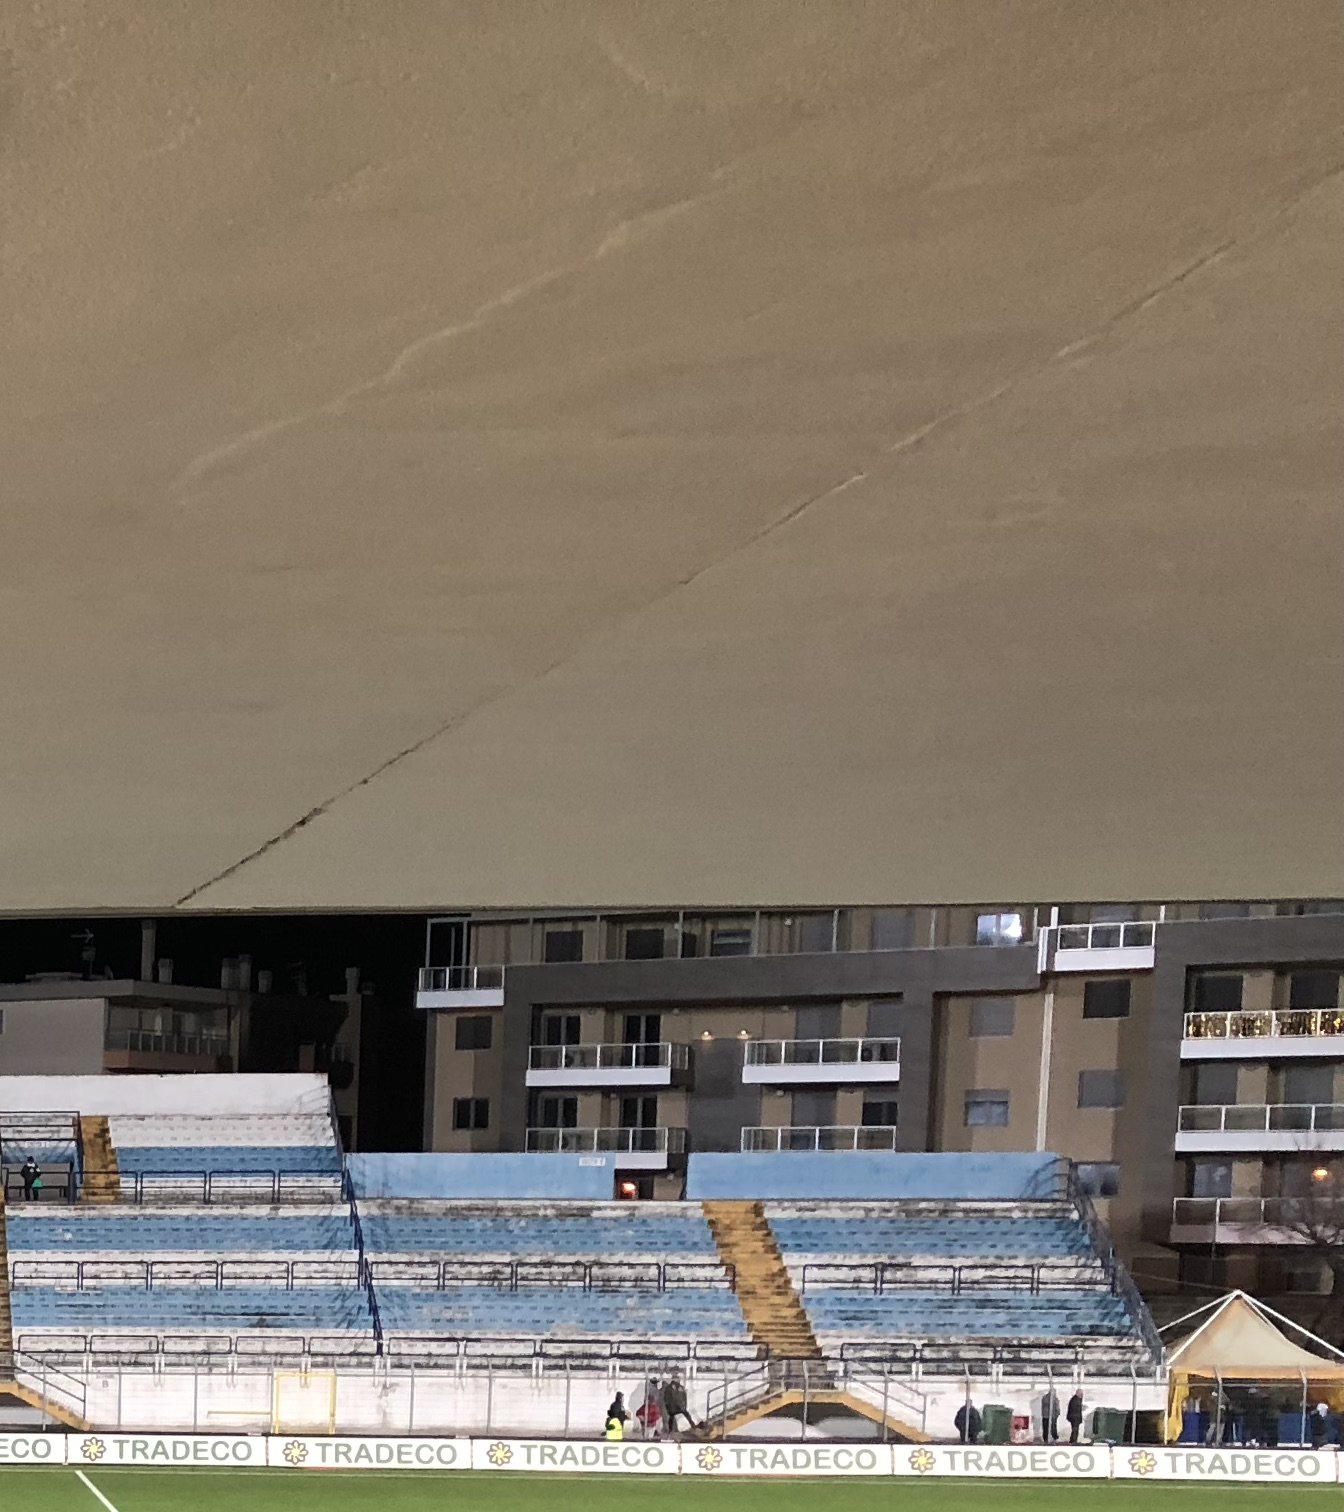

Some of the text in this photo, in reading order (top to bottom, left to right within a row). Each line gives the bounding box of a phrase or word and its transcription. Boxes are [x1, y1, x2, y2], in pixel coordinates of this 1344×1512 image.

[112, 1439, 252, 1462] TRADECO
[314, 1442, 457, 1465] TRADECO
[520, 1444, 664, 1468] TRADECO
[729, 1448, 877, 1470] TRADECO
[945, 1450, 1095, 1473] TRADECO
[1164, 1452, 1321, 1477] TRADECO
